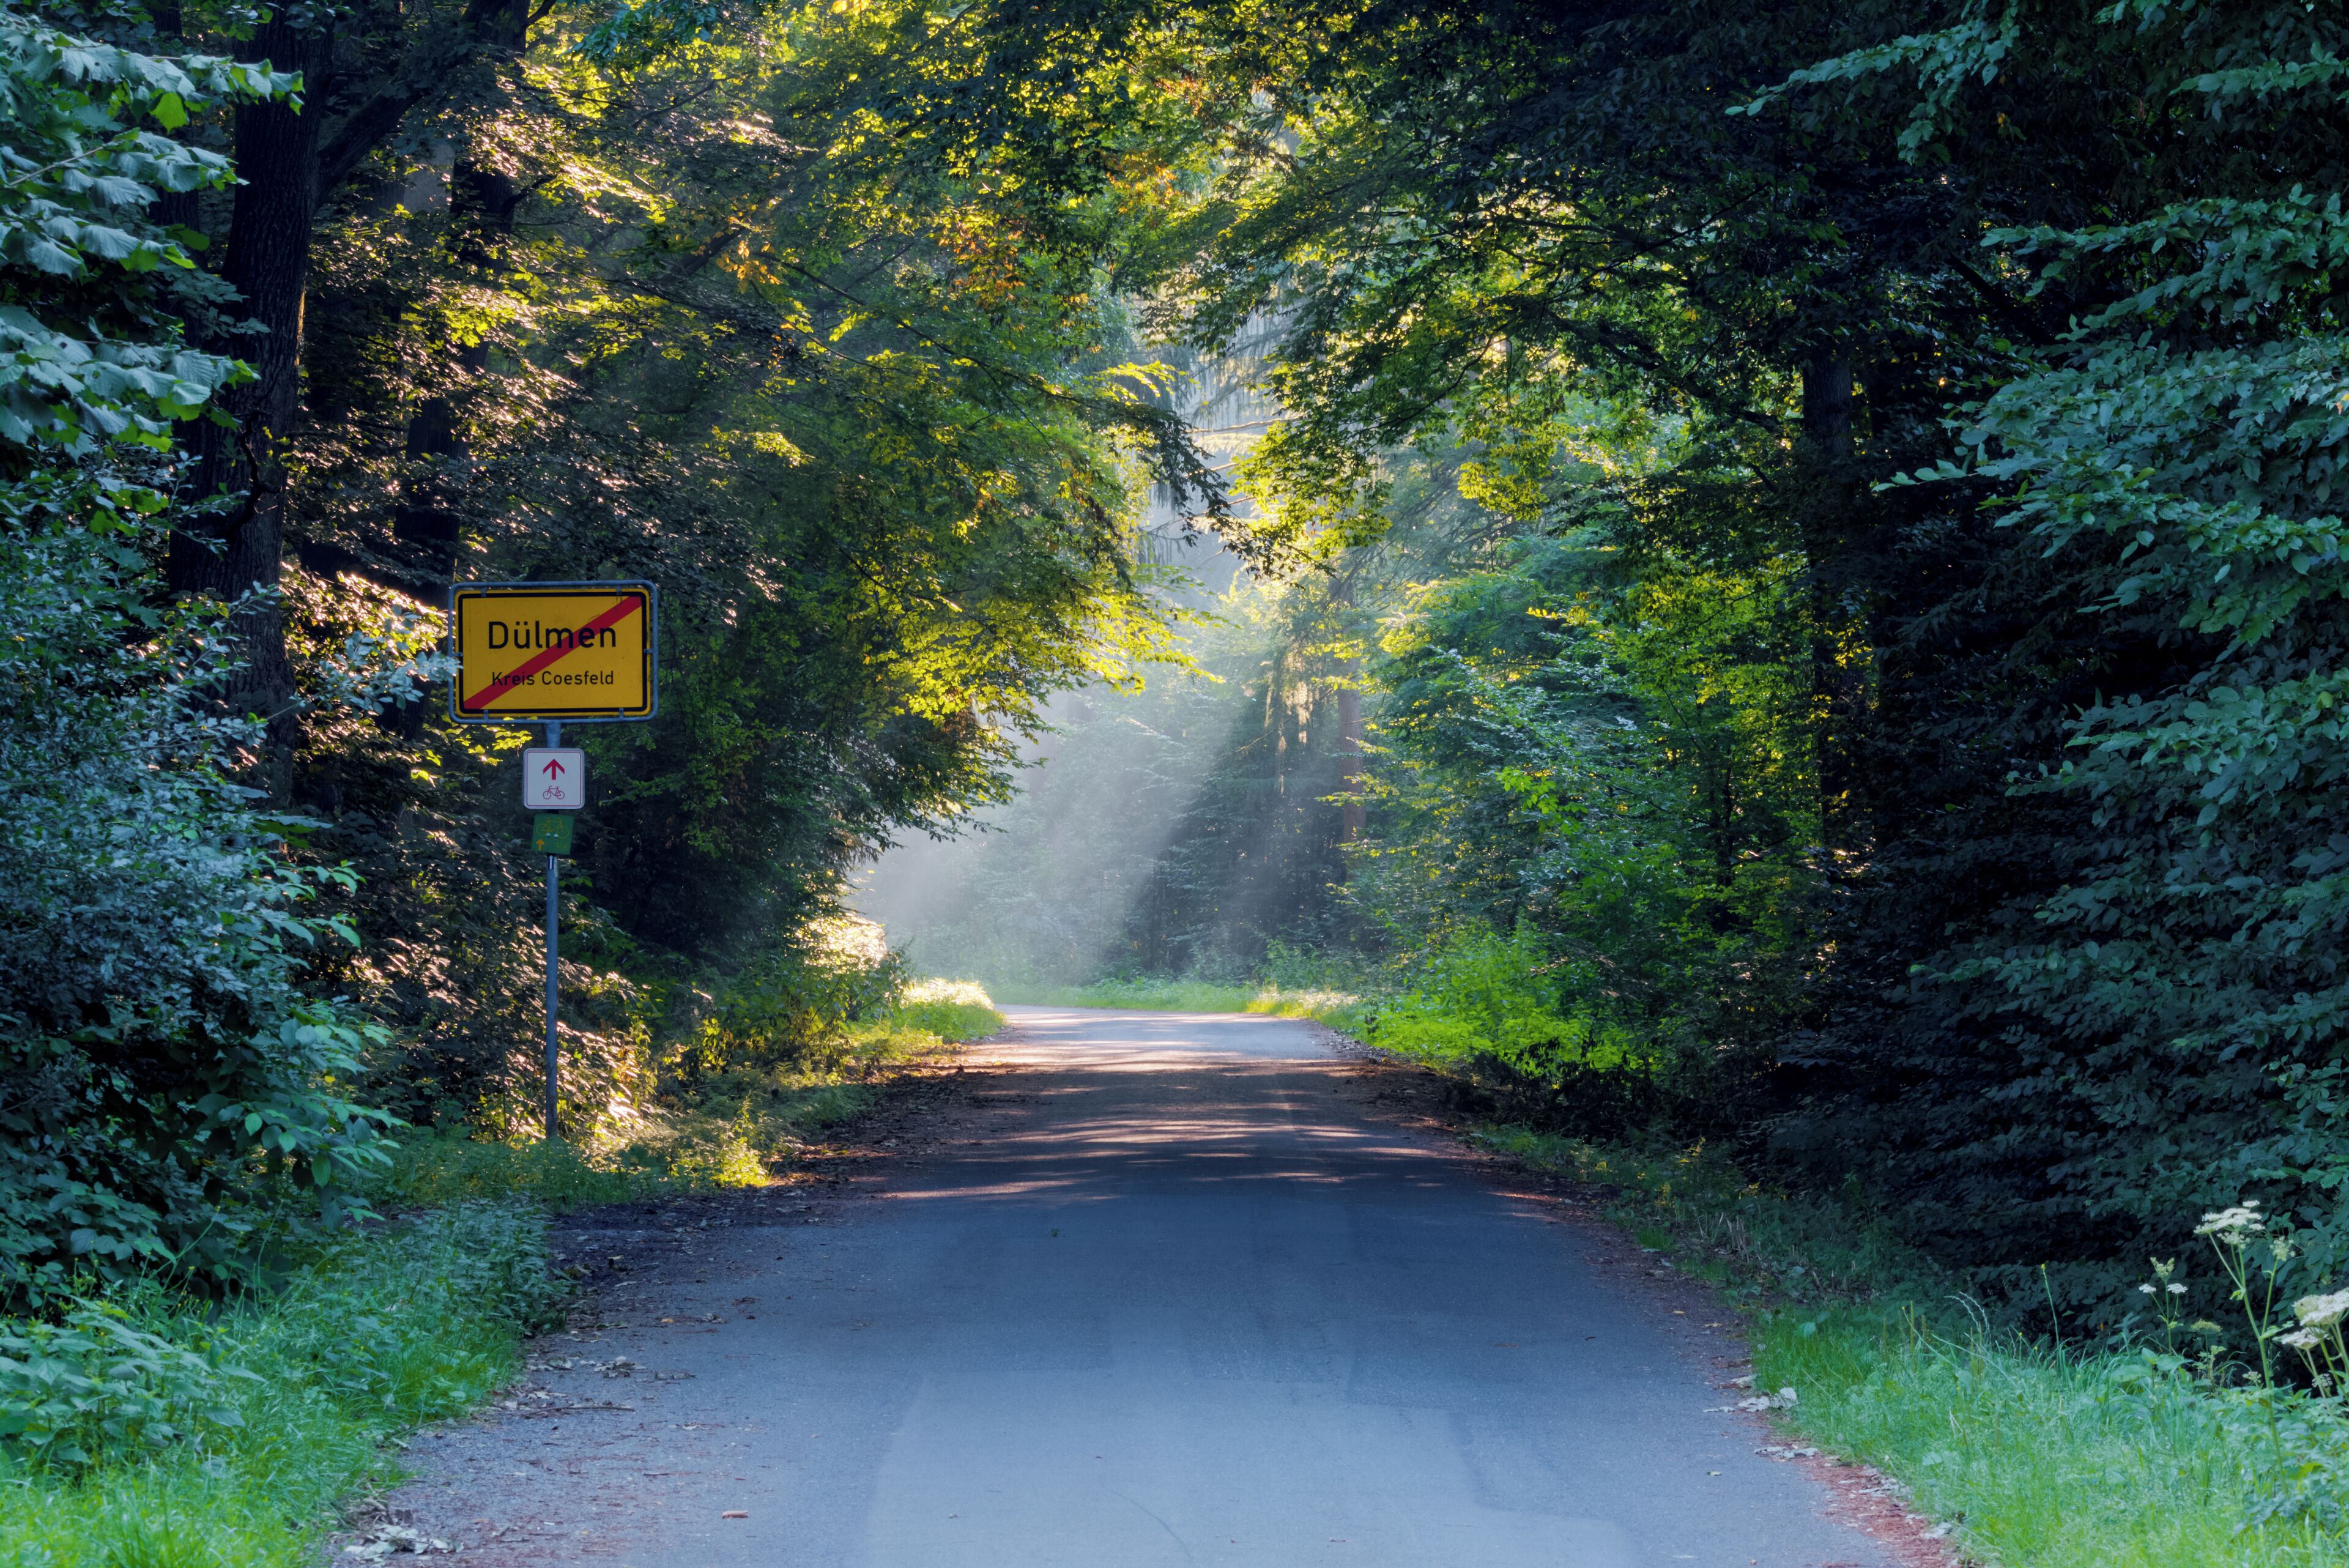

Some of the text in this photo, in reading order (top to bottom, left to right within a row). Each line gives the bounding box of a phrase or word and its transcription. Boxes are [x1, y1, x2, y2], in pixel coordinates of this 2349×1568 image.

[489, 620, 616, 648] Dülmen
[492, 671, 614, 686] Kreis Coesfeld
